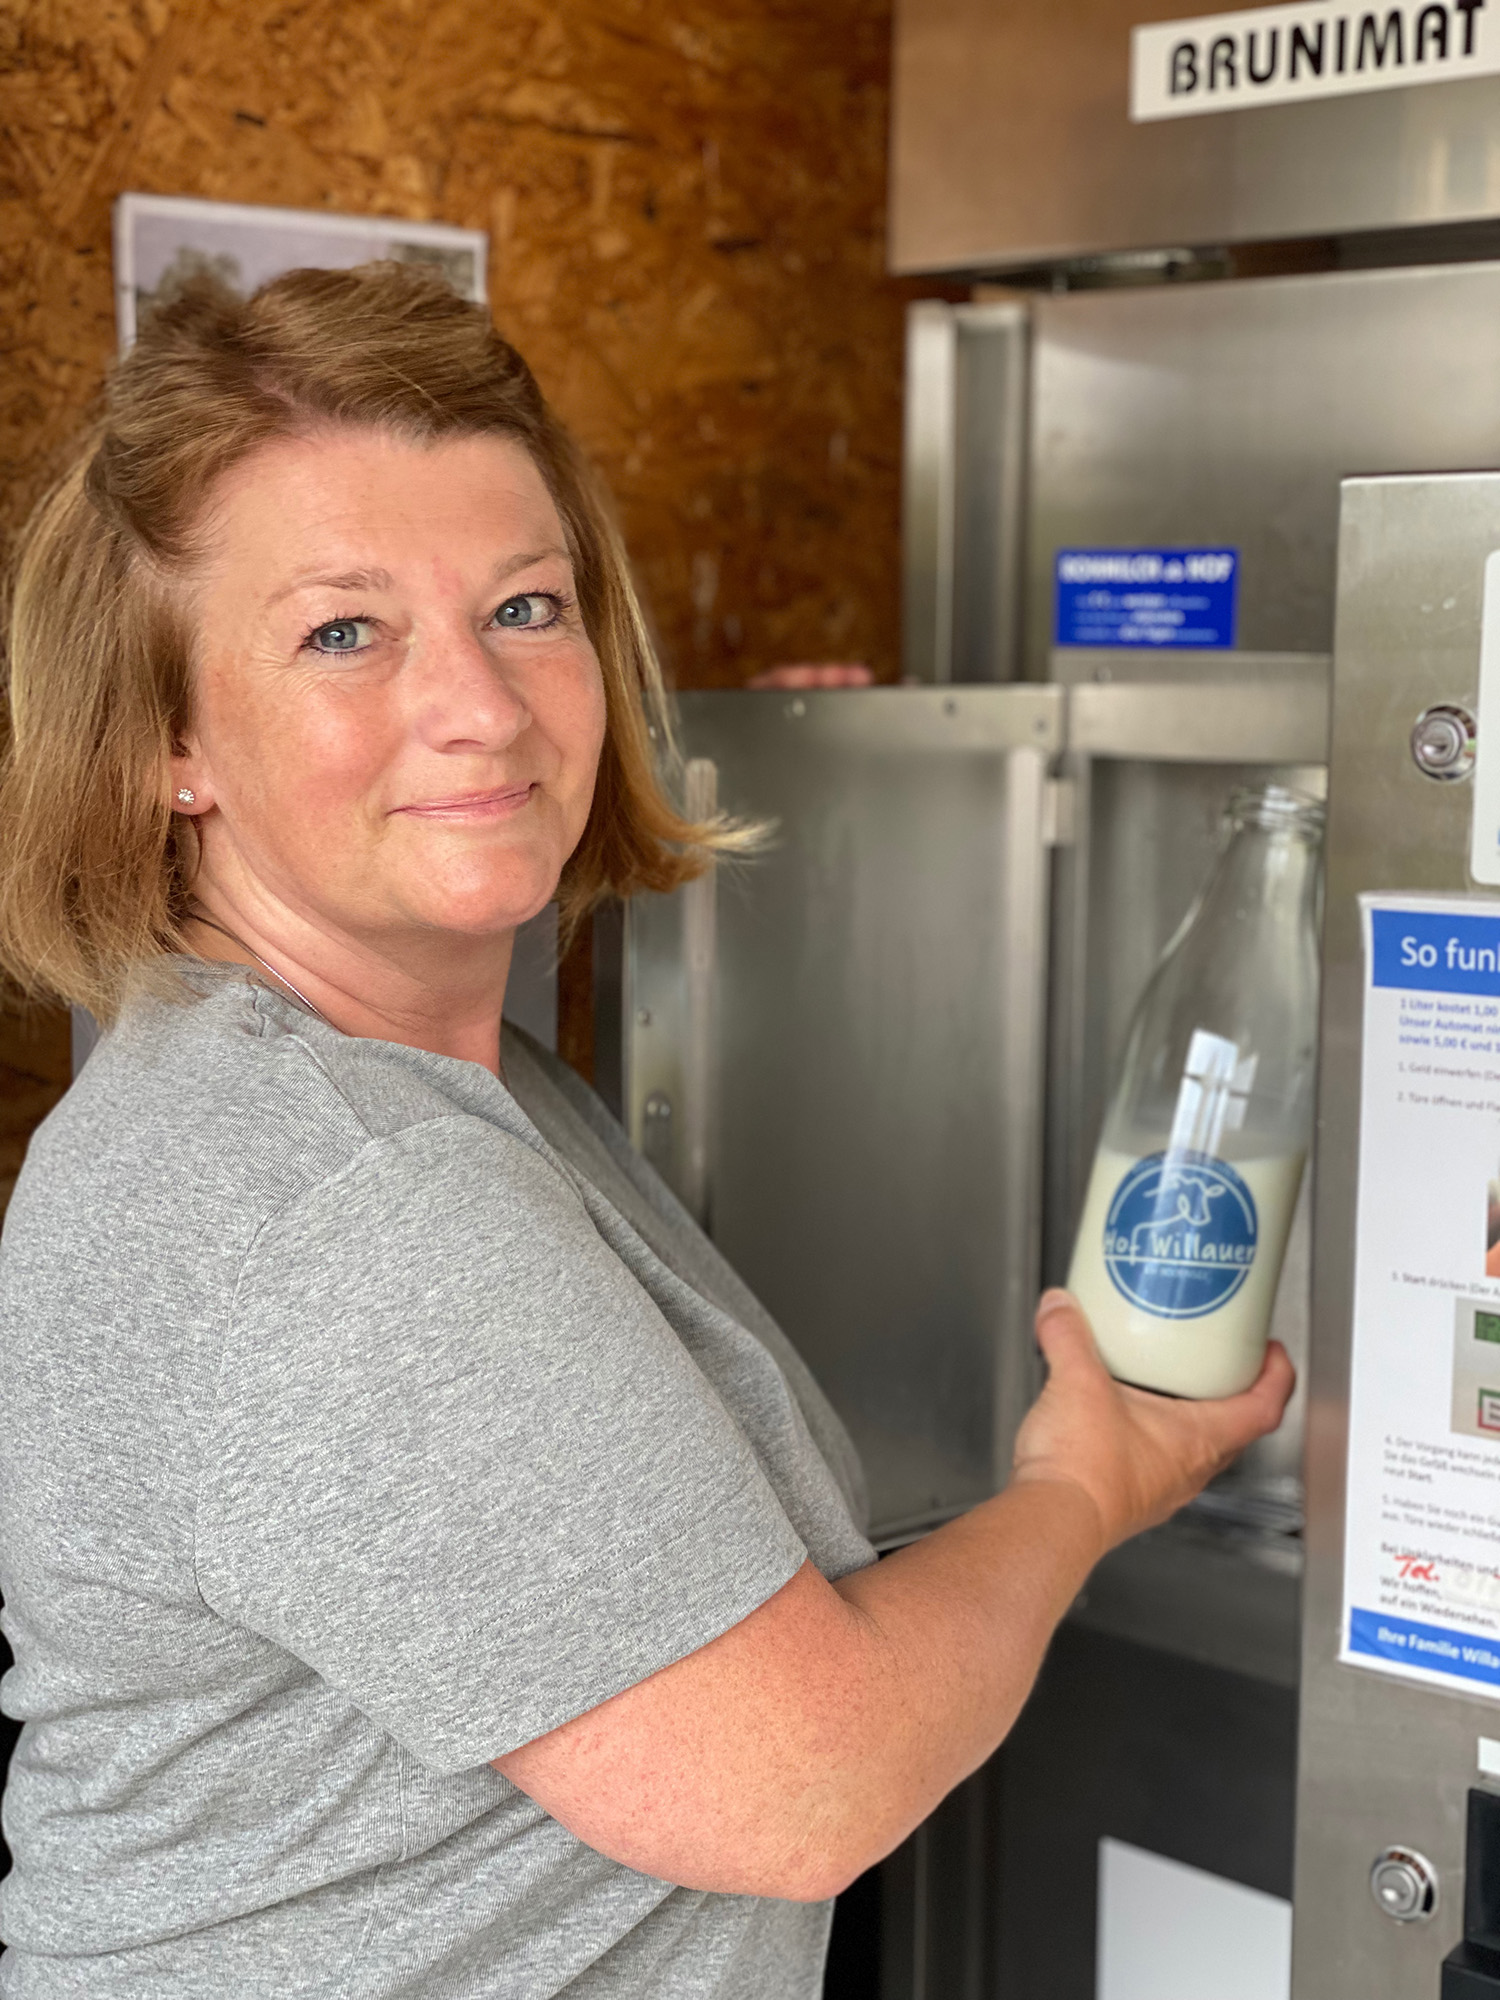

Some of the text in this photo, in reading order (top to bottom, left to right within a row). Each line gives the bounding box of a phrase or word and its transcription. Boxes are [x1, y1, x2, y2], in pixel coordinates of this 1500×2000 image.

[1170, 0, 1484, 94] BRUNIMAT
[1400, 936, 1437, 967] So
[1409, 999, 1433, 1010] Liter
[1437, 1002, 1470, 1014] kostet
[1400, 1015, 1430, 1027] Unser
[1435, 1019, 1483, 1033] Automat
[1151, 1229, 1255, 1262] Willauer
[1377, 1626, 1406, 1648] Ihre
[1408, 1634, 1460, 1660] Familie
